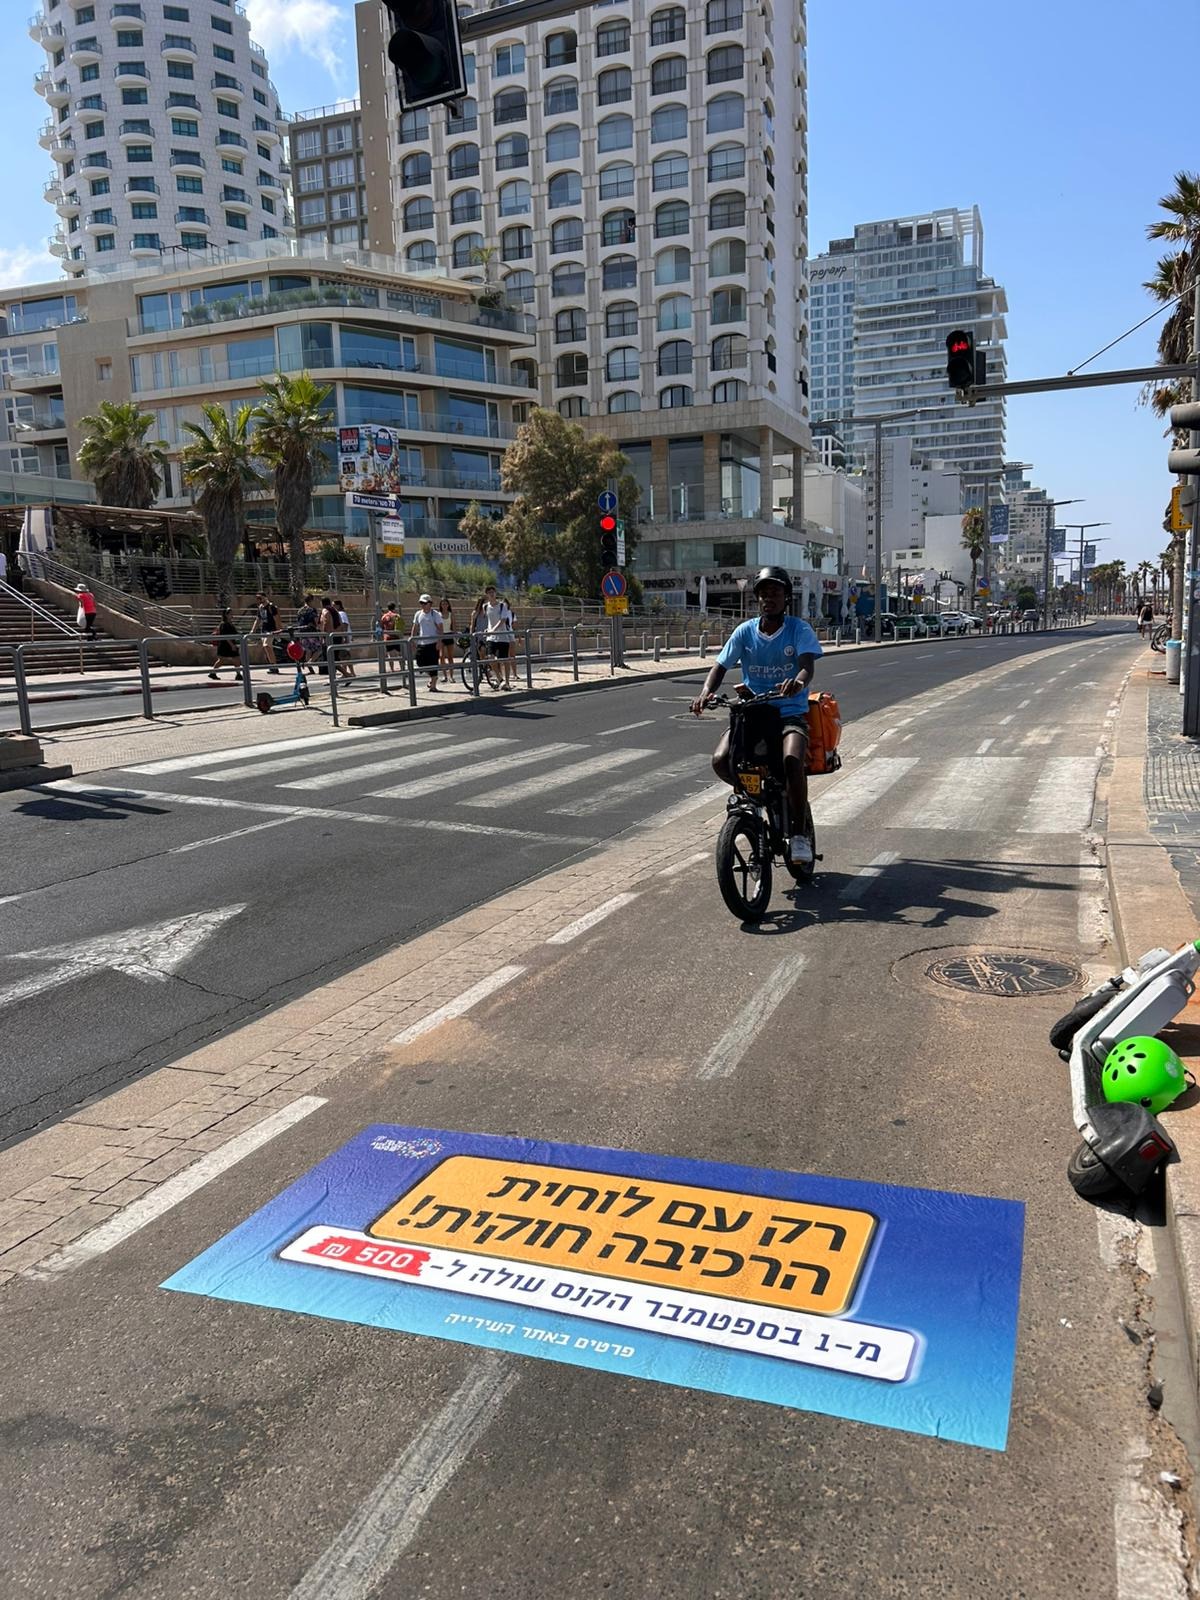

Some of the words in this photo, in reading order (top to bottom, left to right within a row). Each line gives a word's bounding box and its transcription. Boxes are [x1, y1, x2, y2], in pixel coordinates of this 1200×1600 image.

[748, 663, 794, 673] ETIHAD
[486, 1175, 655, 1218] לוחית
[397, 1195, 593, 1254] חוקית!
[657, 1200, 753, 1233] עם
[758, 1215, 847, 1252] רק
[355, 1248, 413, 1269] 500
[597, 1232, 831, 1296] הרכיבה
[469, 1267, 548, 1293] עולה
[551, 1283, 633, 1312] הקנס
[444, 1313, 514, 1335] העירייה
[522, 1327, 571, 1346] באתר
[646, 1299, 802, 1346] בספטמבר
[574, 1337, 635, 1358] פרטים
